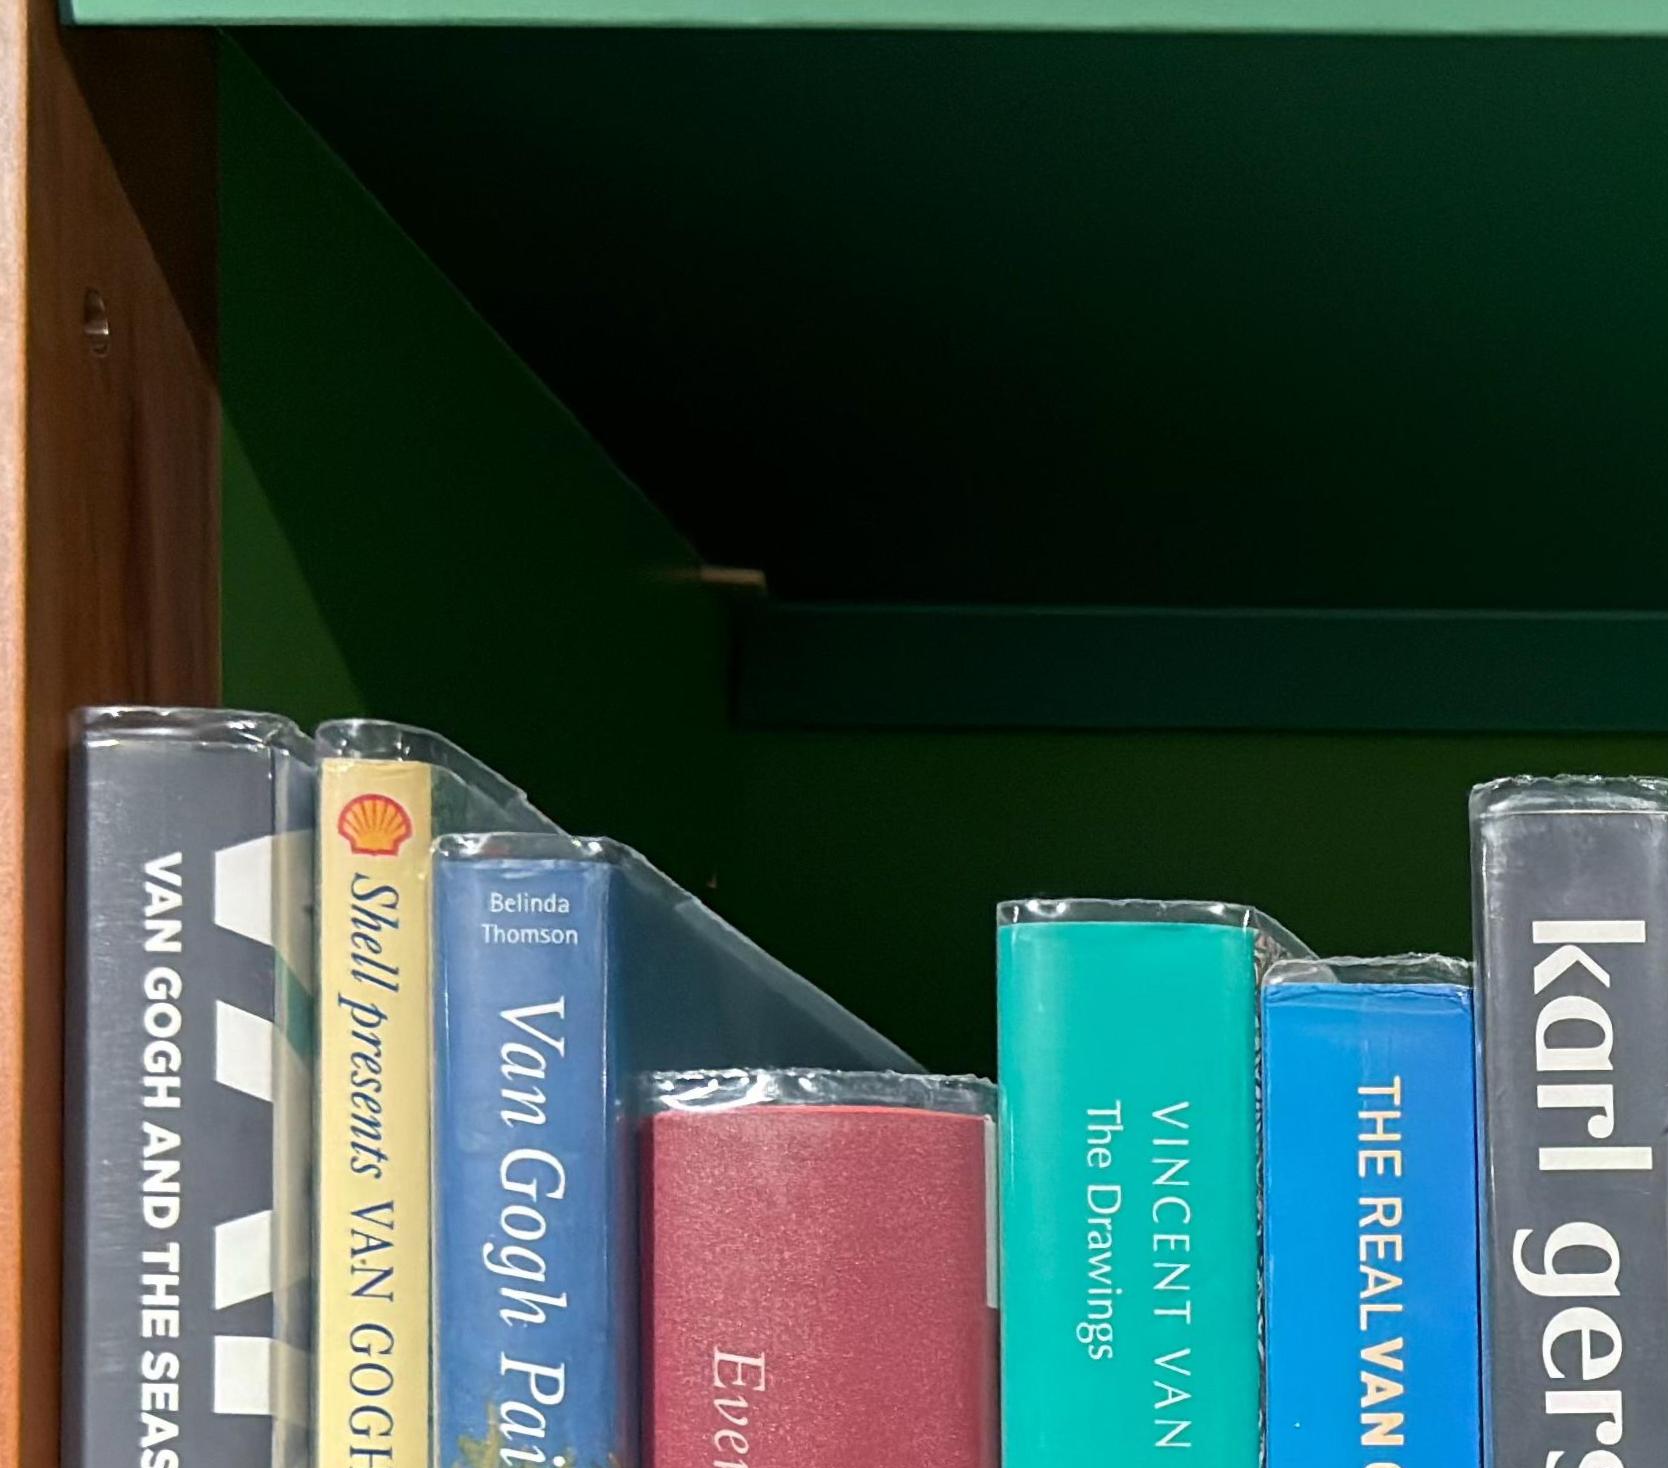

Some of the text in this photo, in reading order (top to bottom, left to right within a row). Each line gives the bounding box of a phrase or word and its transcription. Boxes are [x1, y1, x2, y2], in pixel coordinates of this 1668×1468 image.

[141, 851, 183, 950] VAN
[350, 873, 399, 992] Shell
[481, 923, 579, 946] Thomson
[488, 892, 570, 914] Belinda
[140, 966, 183, 1108] GOGH
[339, 992, 393, 1180] presents
[499, 995, 566, 1128] Van
[1531, 918, 1653, 1171] karl
[140, 1121, 182, 1228] AND
[1357, 1075, 1403, 1178] THE
[349, 1199, 395, 1302] VAN
[482, 1148, 567, 1327] Gogh
[1076, 1100, 1123, 1361] The Drawings
[1151, 1100, 1193, 1325] VINCENT
[1359, 1196, 1404, 1331] REAL
[140, 1242, 181, 1337] THE
[1153, 1347, 1193, 1450] VAN
[1360, 1336, 1404, 1446] VAN
